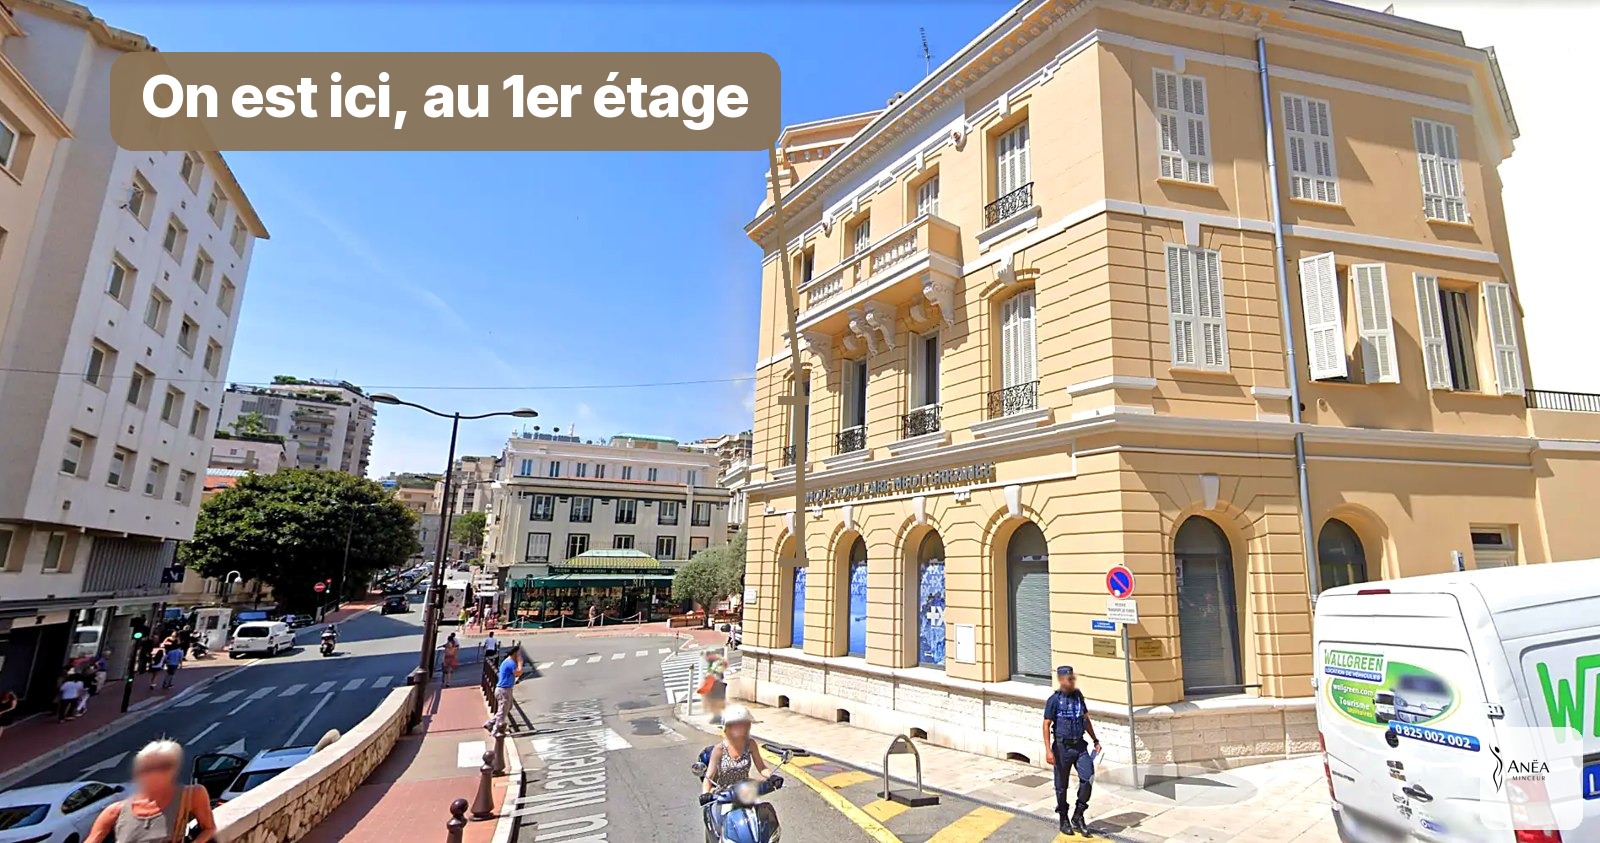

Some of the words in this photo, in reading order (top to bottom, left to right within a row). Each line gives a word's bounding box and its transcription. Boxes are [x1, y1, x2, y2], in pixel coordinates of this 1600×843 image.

[1324, 649, 1384, 671] WALLGREEN
[1339, 696, 1370, 710] Tourisme
[1395, 725, 1402, 734] 0
[1404, 725, 1423, 739] 825
[1425, 729, 1446, 743] 002
[1448, 734, 1472, 749] 002
